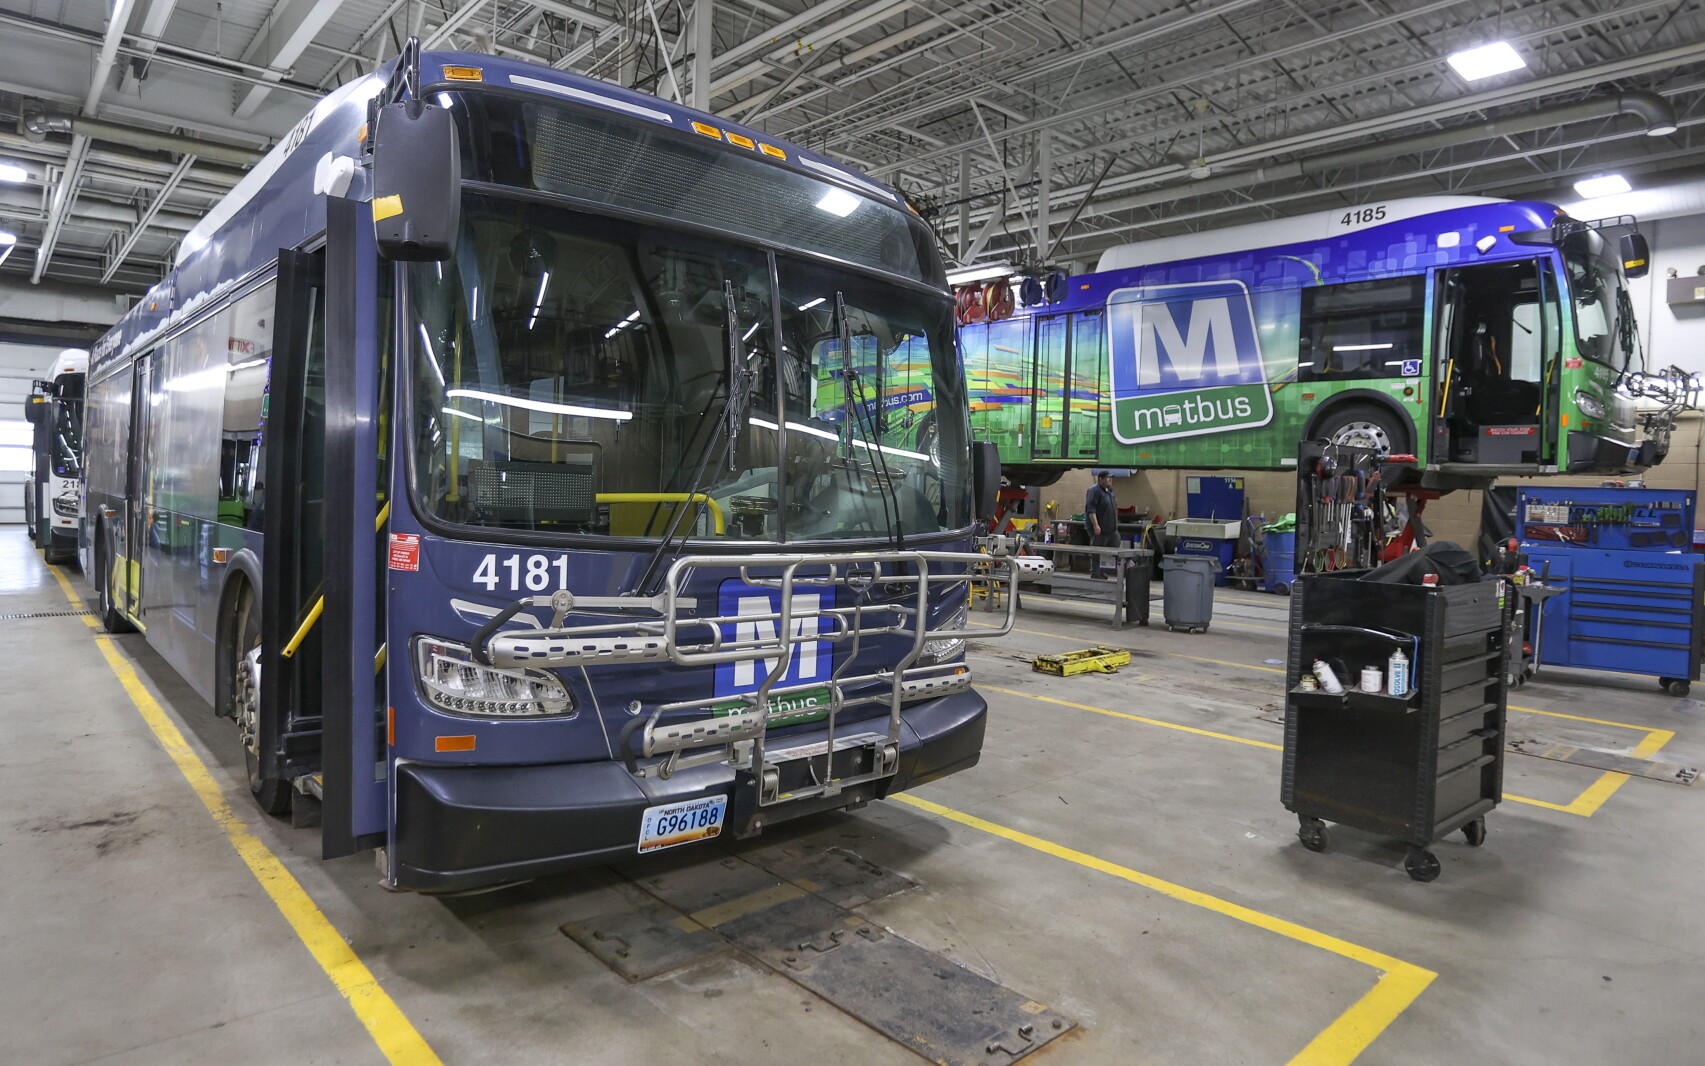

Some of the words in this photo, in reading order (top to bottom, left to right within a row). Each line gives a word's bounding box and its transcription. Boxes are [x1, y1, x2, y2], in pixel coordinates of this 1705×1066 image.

[1341, 205, 1387, 226] 4185
[1132, 297, 1241, 386] M
[472, 554, 568, 591] 4181
[734, 594, 820, 687] M
[656, 807, 719, 836] G96188
[664, 806, 685, 816] NORTH
[686, 802, 710, 812] DAKOTA
